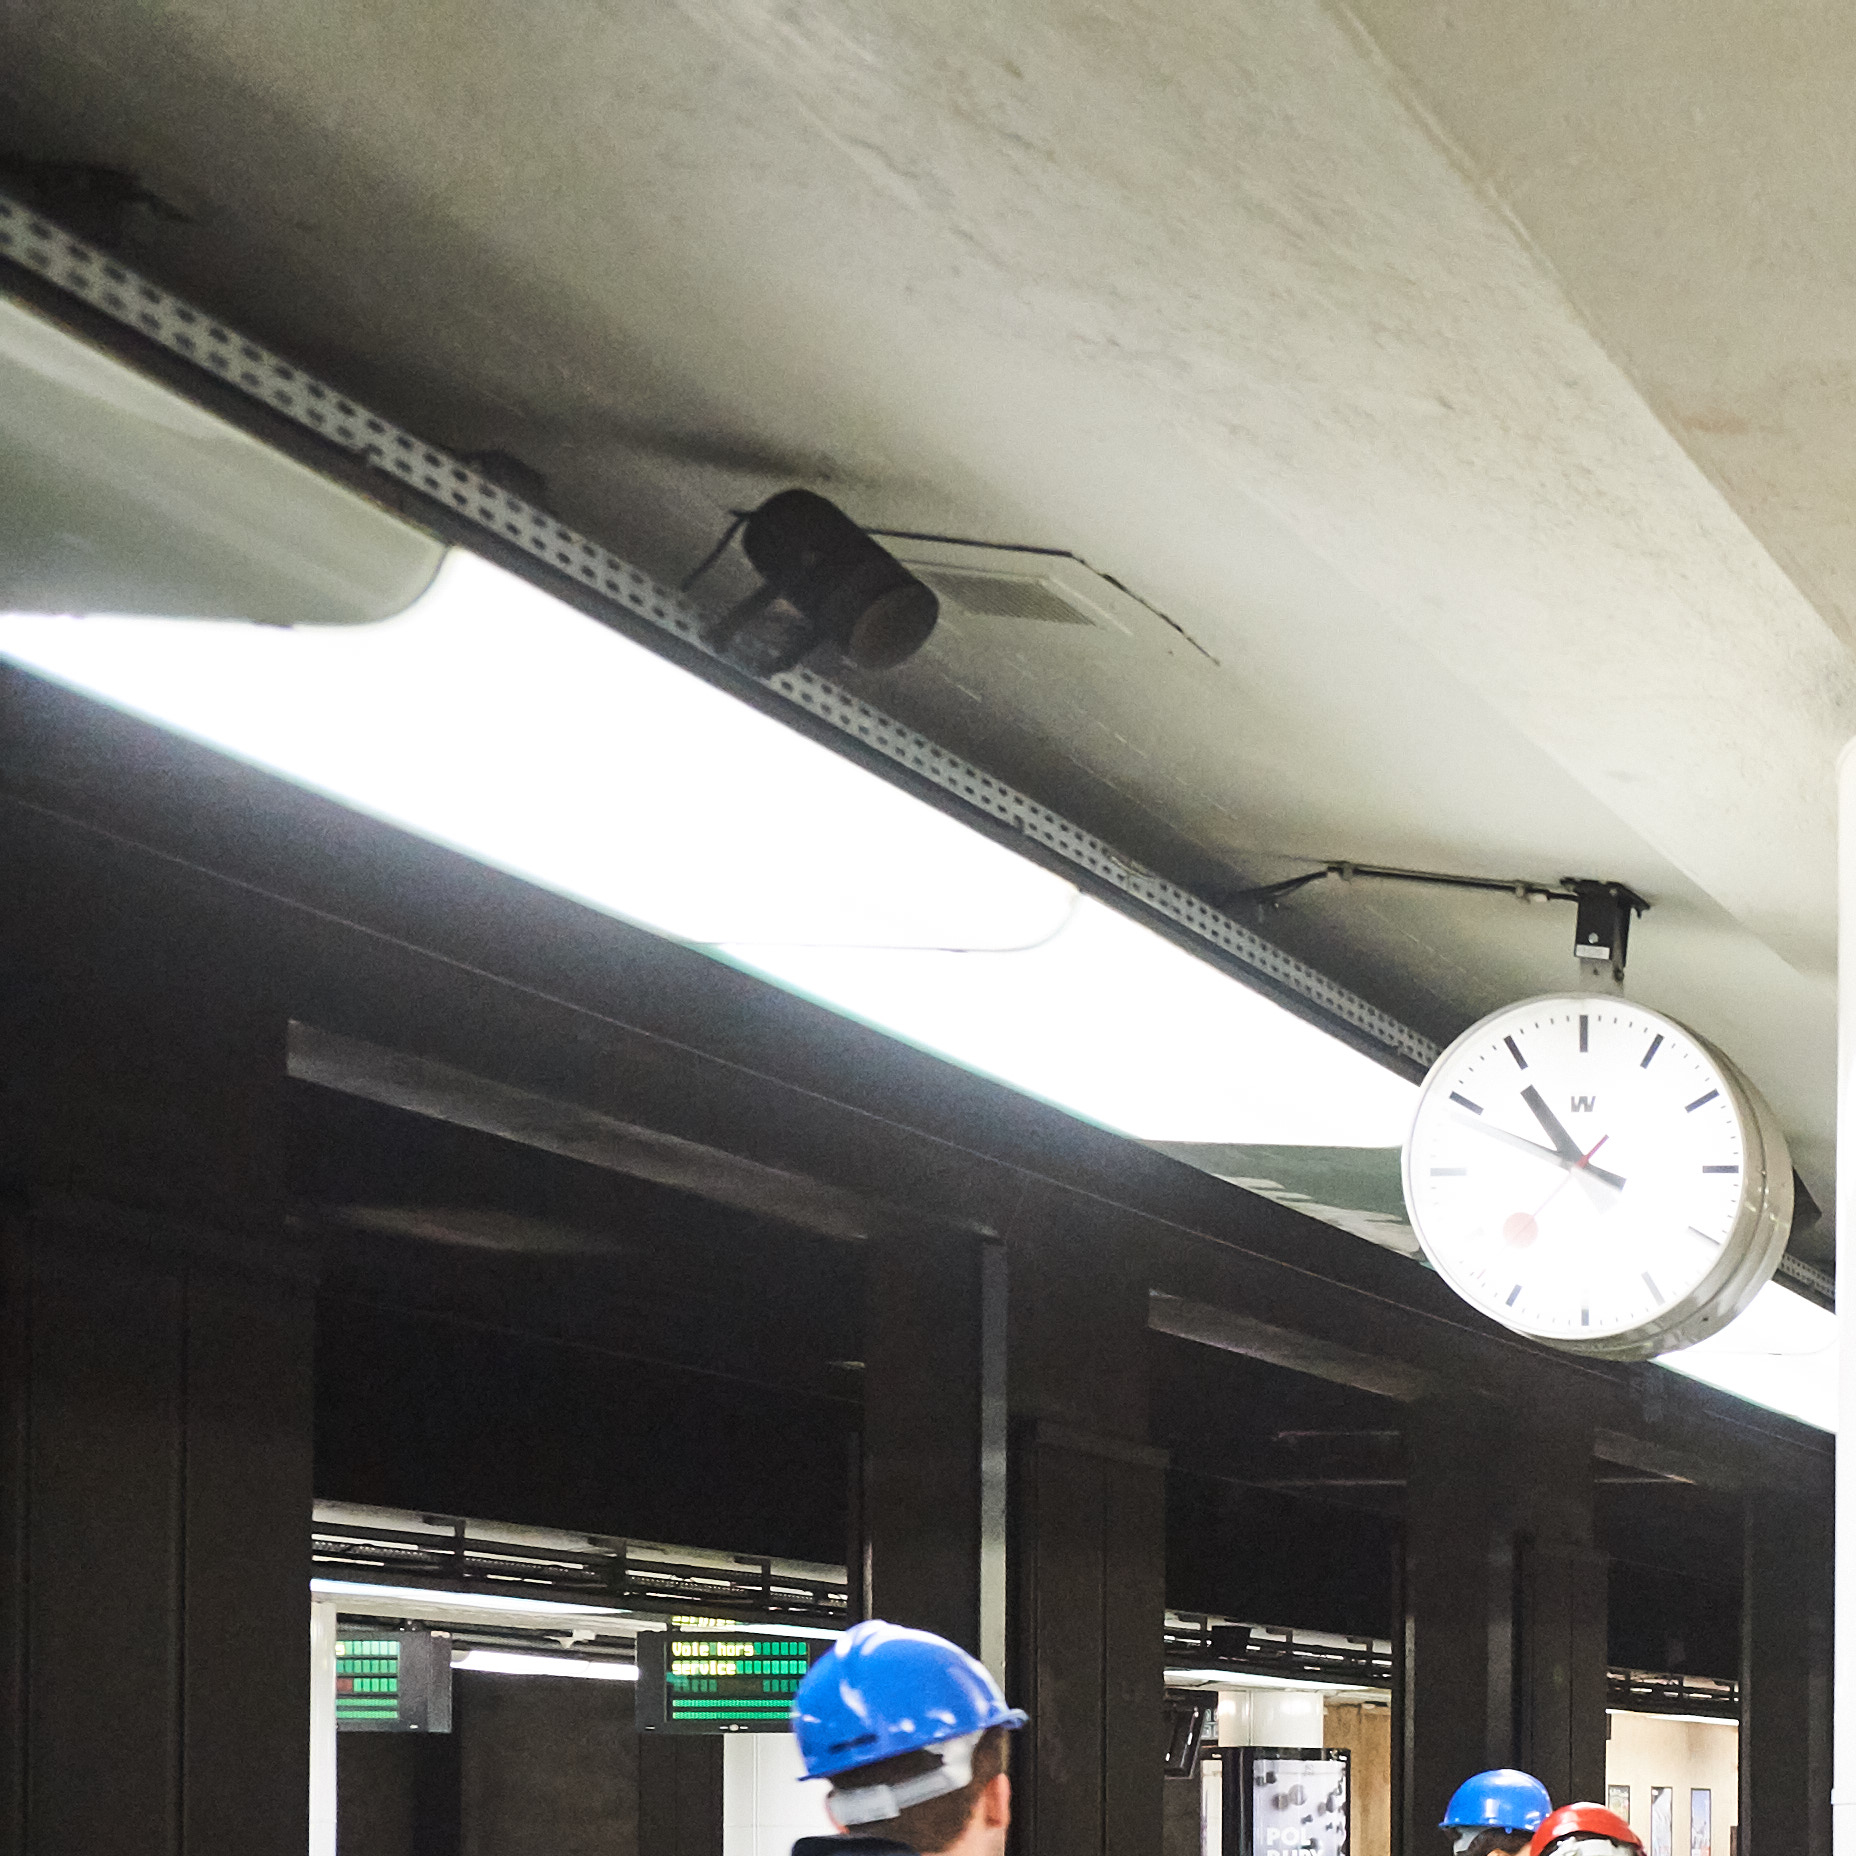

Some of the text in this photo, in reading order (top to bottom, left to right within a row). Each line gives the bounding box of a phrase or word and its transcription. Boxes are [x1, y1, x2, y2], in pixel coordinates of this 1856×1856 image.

[672, 1642, 754, 1657] Voie hors
[672, 1660, 736, 1675] service
[1266, 1827, 1311, 1846] POL
